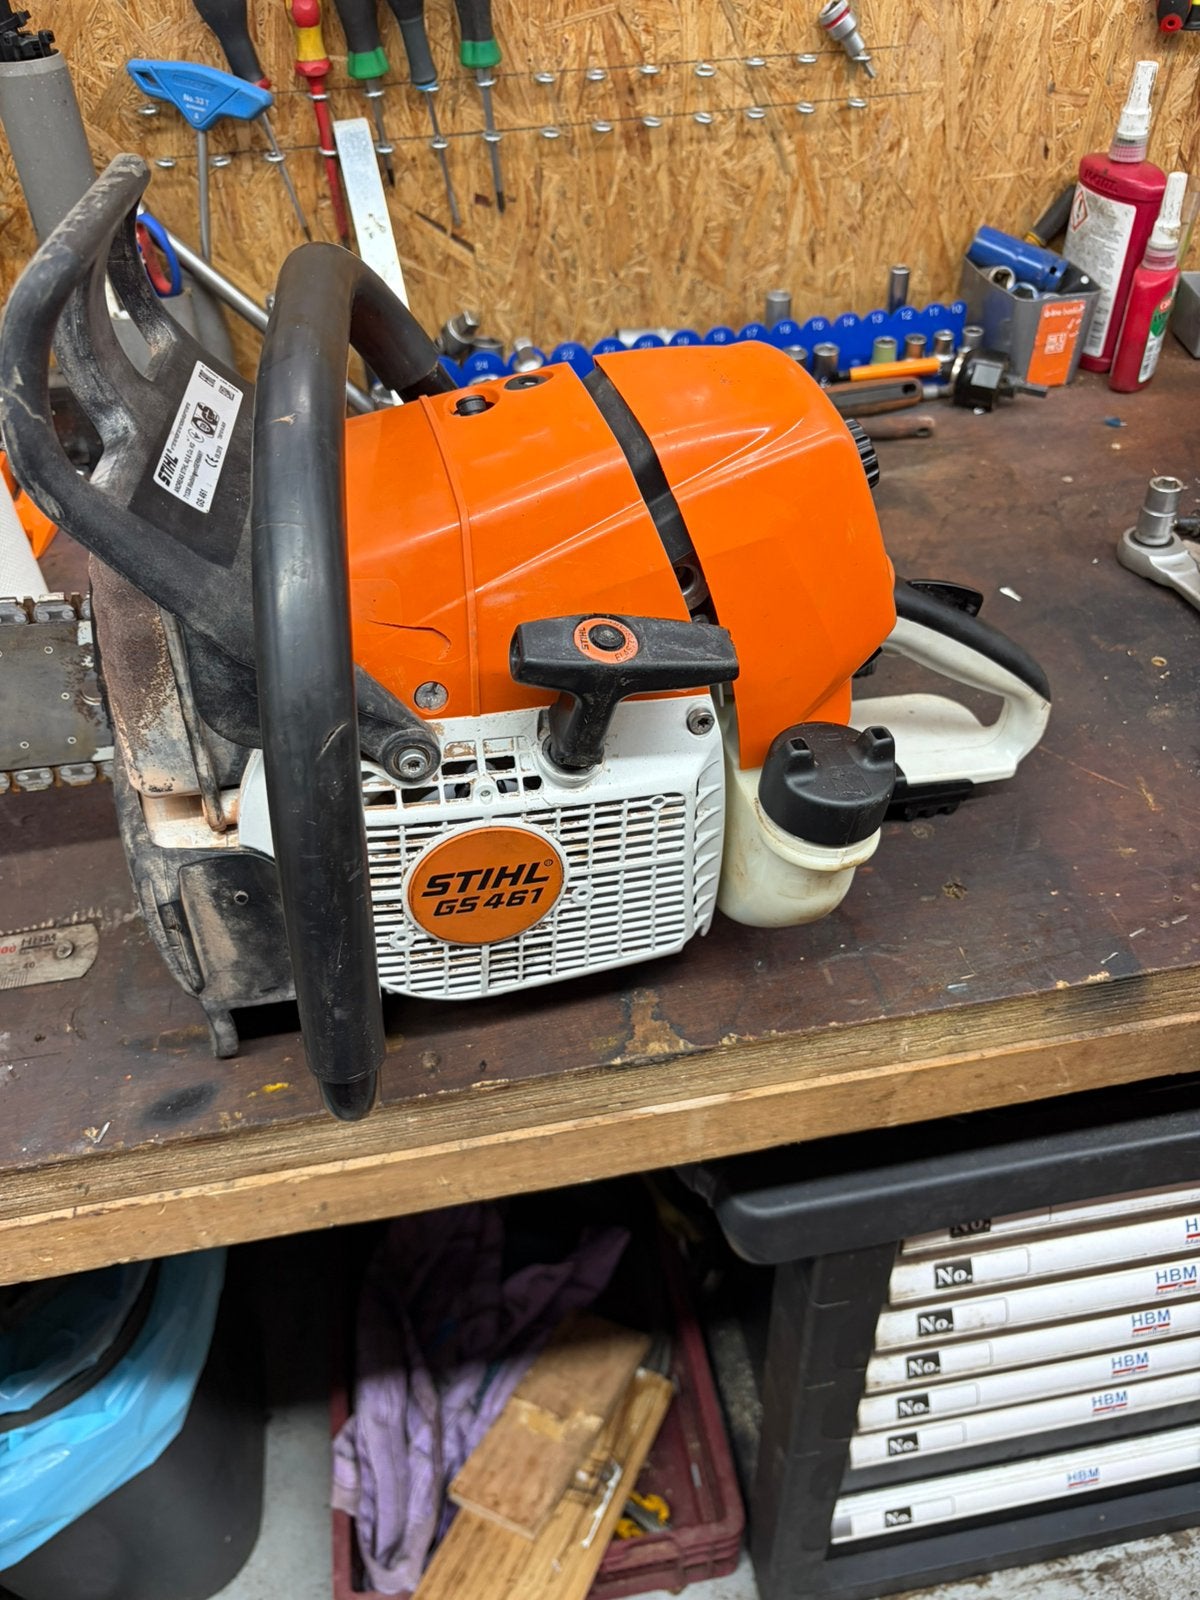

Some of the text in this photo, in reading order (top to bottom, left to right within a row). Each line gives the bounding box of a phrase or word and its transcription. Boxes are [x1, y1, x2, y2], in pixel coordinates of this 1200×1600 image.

[475, 360, 488, 370] 24
[561, 350, 574, 361] 22
[677, 335, 689, 345] 19
[714, 331, 725, 342] 18
[746, 328, 758, 338] 17
[780, 324, 791, 334] 16
[812, 320, 824, 331] 15
[843, 317, 854, 327] 14
[872, 313, 883, 323] 13
[901, 310, 912, 320] 12
[929, 307, 939, 316] 11
[952, 304, 962, 314] 10
[579, 627, 589, 650] STIHL
[421, 862, 549, 897] STIHL
[433, 888, 544, 917] GS 461
[21, 933, 57, 947] HBM
[936, 1266, 972, 1286] No.
[1156, 1265, 1197, 1284] HBM
[919, 1316, 953, 1334] No.
[1131, 1308, 1171, 1328] HBM
[908, 1359, 941, 1377] No.
[1111, 1351, 1149, 1369] HBM
[1092, 1390, 1128, 1407] HBM
[899, 1400, 929, 1417] No.
[889, 1438, 919, 1454] No.
[1067, 1467, 1099, 1482] HBM
[886, 1511, 912, 1526] No.
